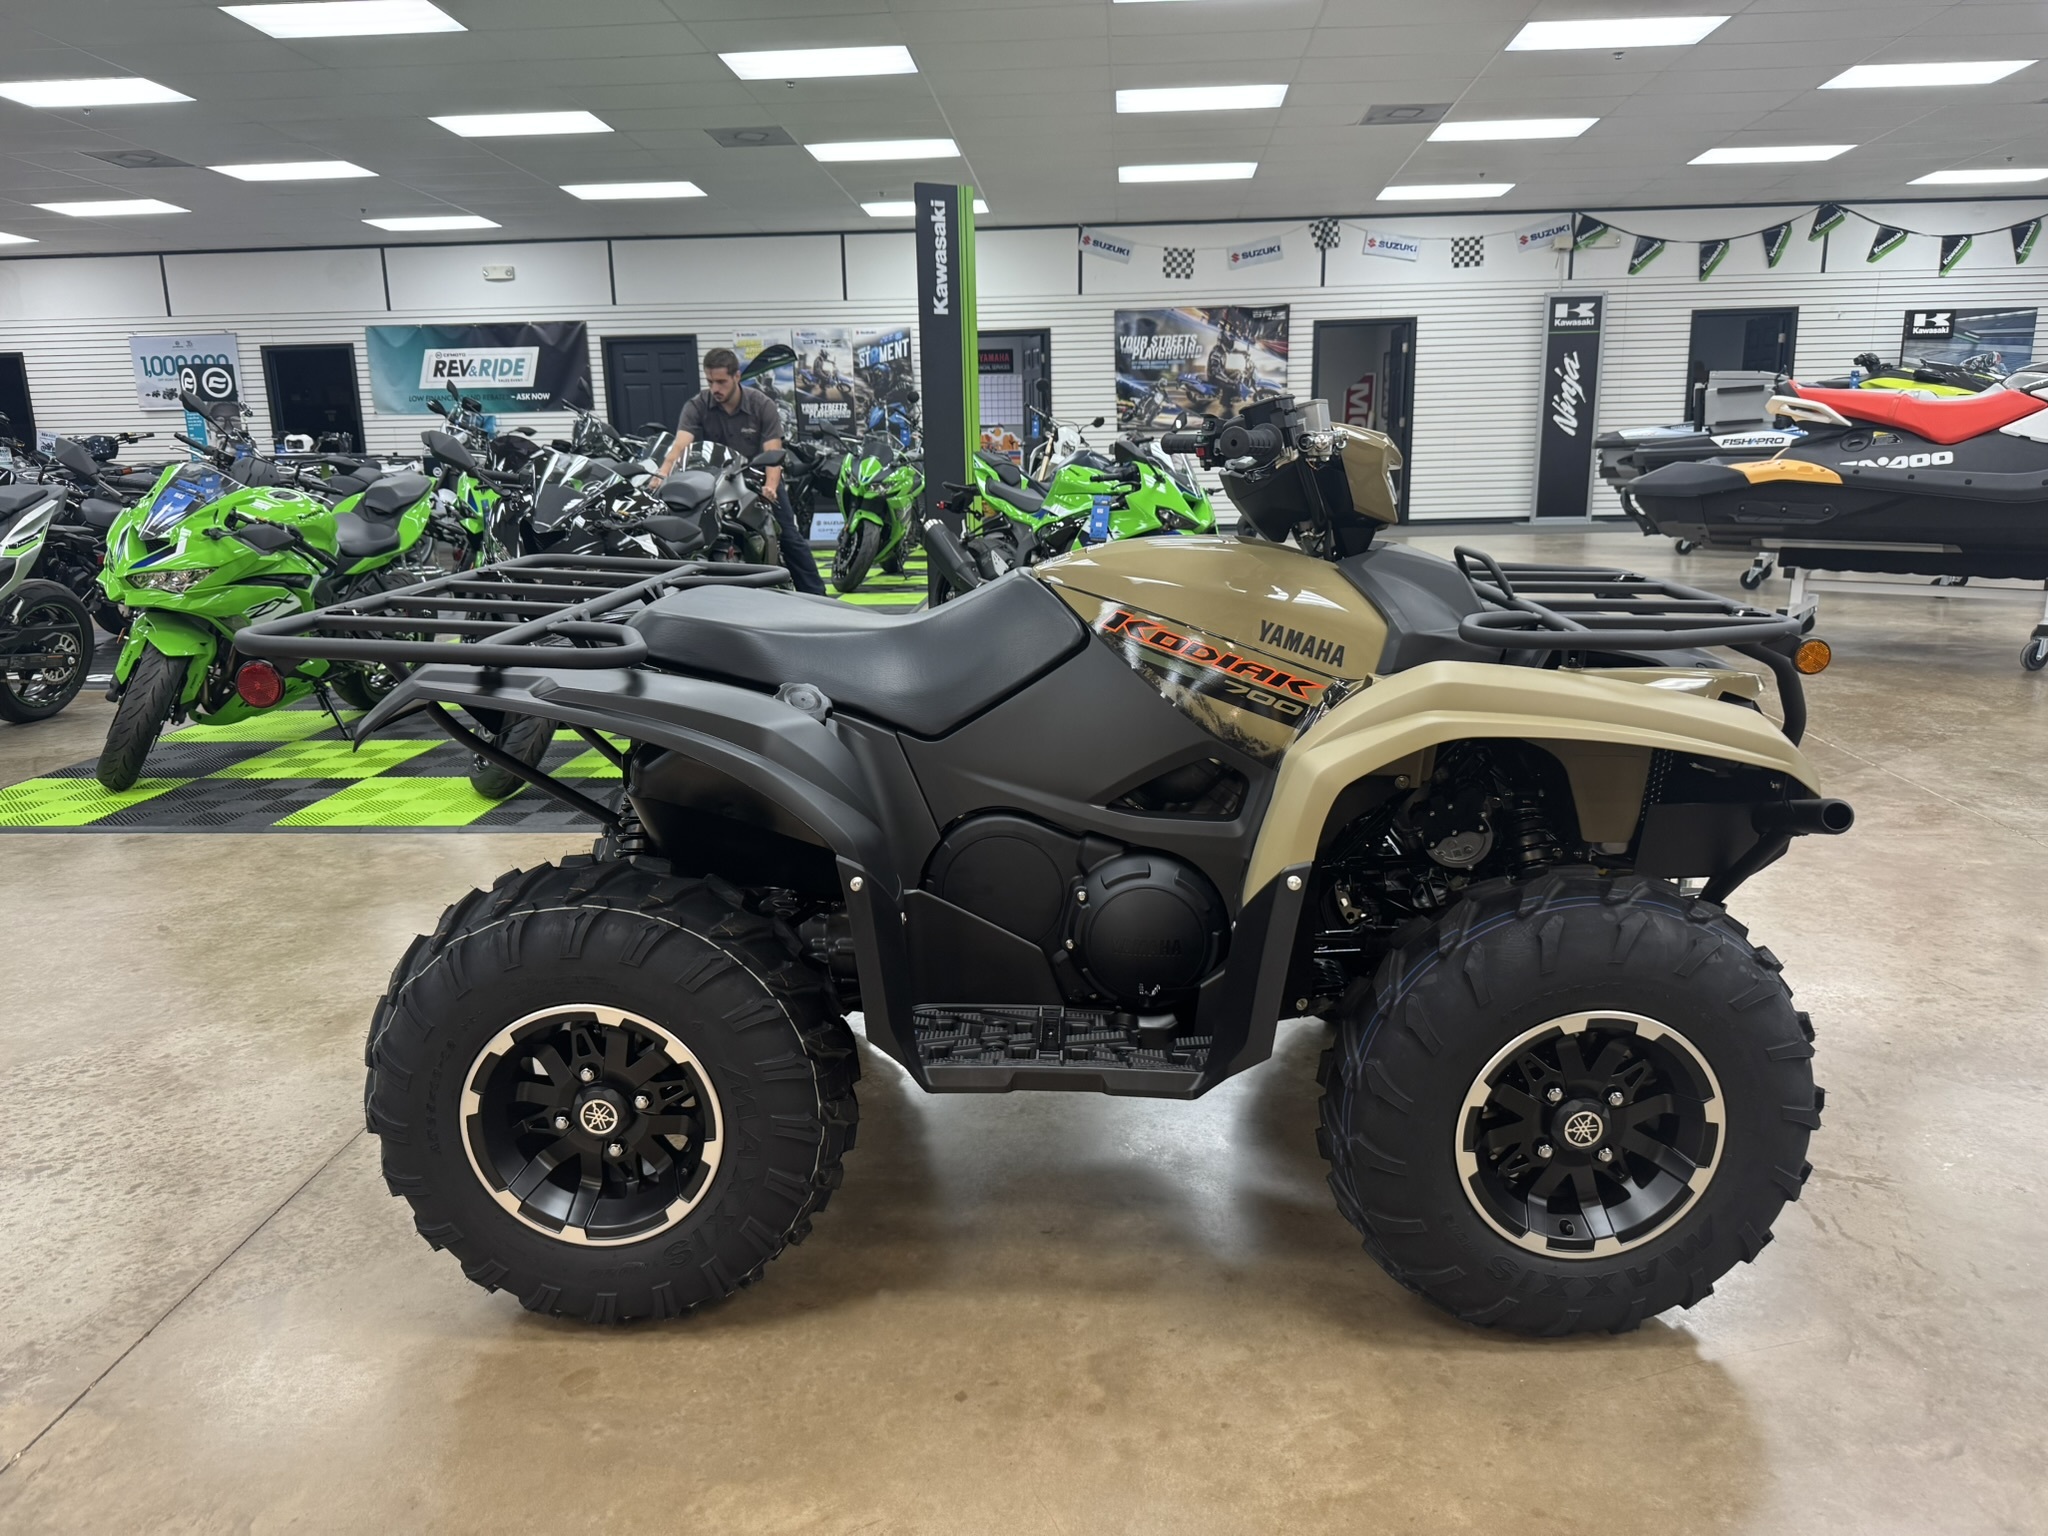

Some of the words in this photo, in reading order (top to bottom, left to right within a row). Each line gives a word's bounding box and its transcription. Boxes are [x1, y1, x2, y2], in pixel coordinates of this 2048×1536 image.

[1530, 223, 1570, 241] SUZUKI
[1815, 210, 1844, 231] Kawasaki
[1576, 224, 1604, 242] Kawasaki
[1769, 225, 1788, 258] Kawasaki
[1873, 230, 1904, 254] Kawasaki
[2016, 220, 2038, 254] Kawasaki
[930, 199, 949, 315] Kawasaki
[1092, 238, 1130, 257] SUZUKI
[1241, 244, 1280, 260] SUZUKI
[1377, 239, 1417, 253] SUZUKI
[1633, 240, 1662, 266] Kawasaki
[1702, 241, 1725, 271] Kawasaki
[1943, 236, 1968, 265] Kawasaki
[1554, 318, 1594, 326] Kawasaki
[1120, 335, 1149, 350] YOUR
[1150, 334, 1198, 350] STREETS
[1131, 344, 1204, 361] PLAYGROUND
[140, 354, 229, 377] 1,000000
[408, 394, 424, 402] LOW
[425, 393, 464, 402] FINANCG
[531, 392, 550, 400] NOW
[1552, 351, 1586, 436] Ninja
[1102, 610, 1327, 700] KODIAK
[1259, 619, 1346, 668] YAMAHA
[1223, 679, 1305, 716] 700
[1112, 936, 1182, 956] YAMAHA
